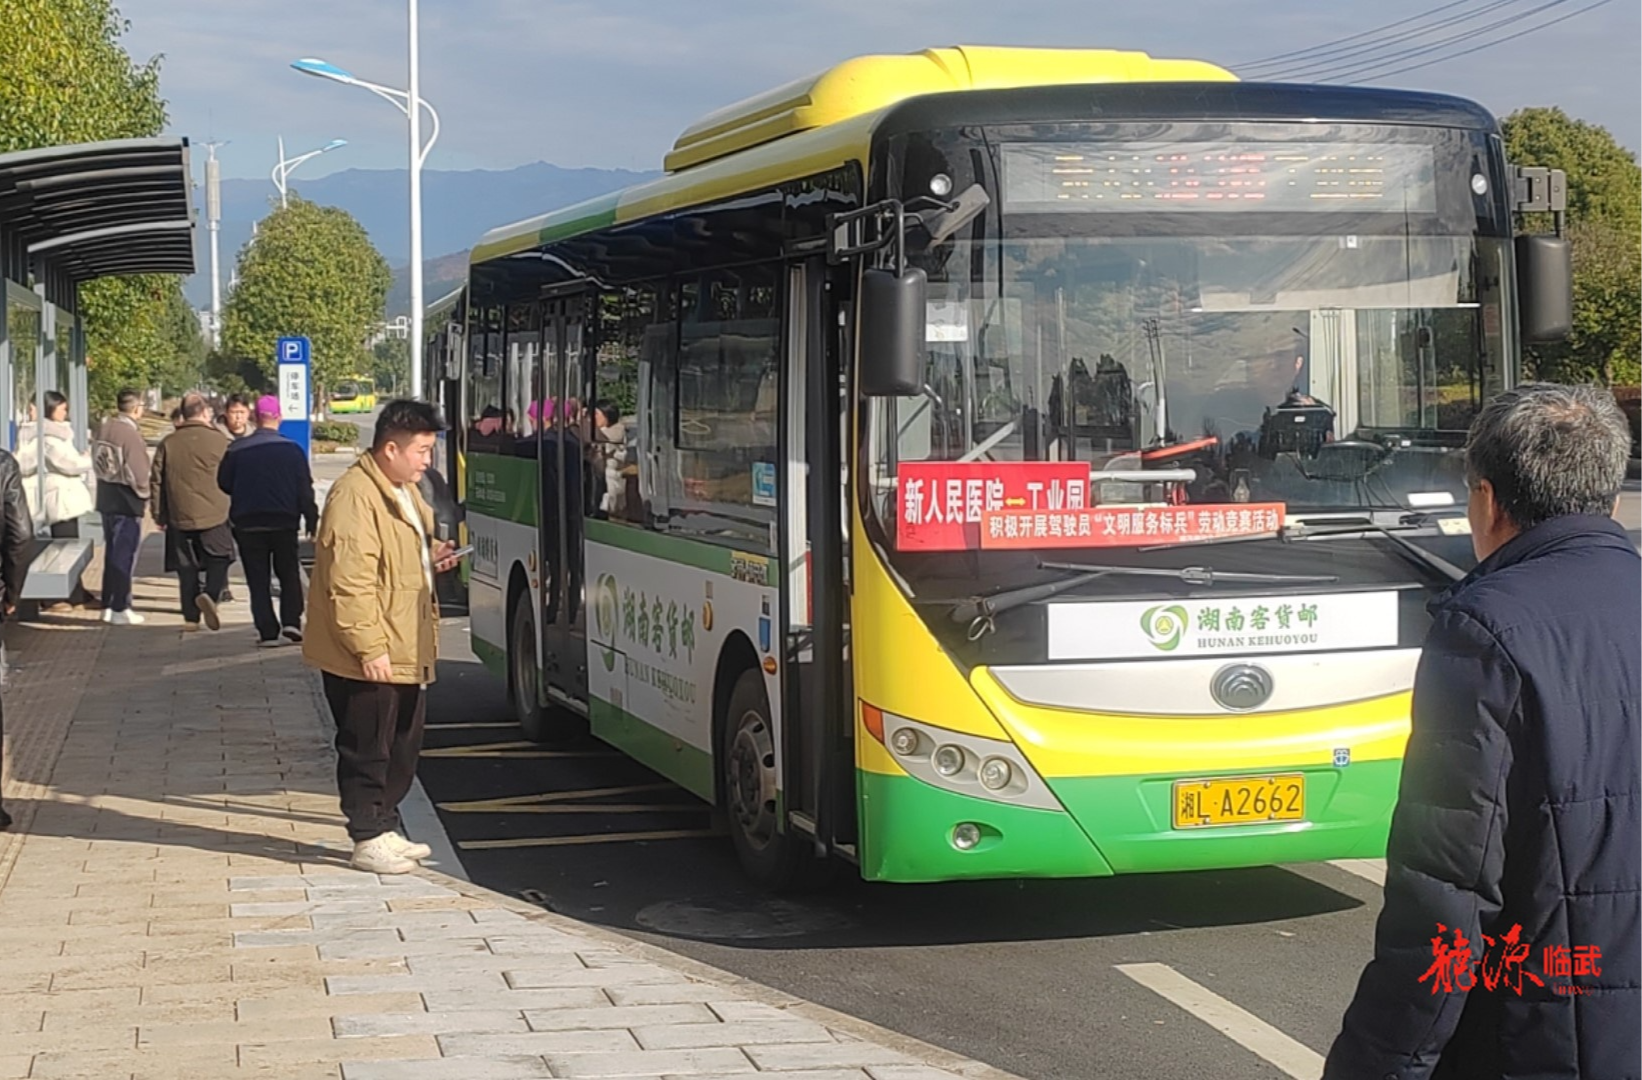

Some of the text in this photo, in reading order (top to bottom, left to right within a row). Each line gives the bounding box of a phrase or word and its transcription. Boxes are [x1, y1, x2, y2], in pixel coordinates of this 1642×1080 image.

[286, 343, 298, 359] P
[290, 371, 300, 400] 停车场
[904, 476, 1085, 525] 新人民医院 工业园
[1197, 603, 1319, 632] 湖南客货邮
[1197, 633, 1318, 649] HUNAN KEHUOYOU
